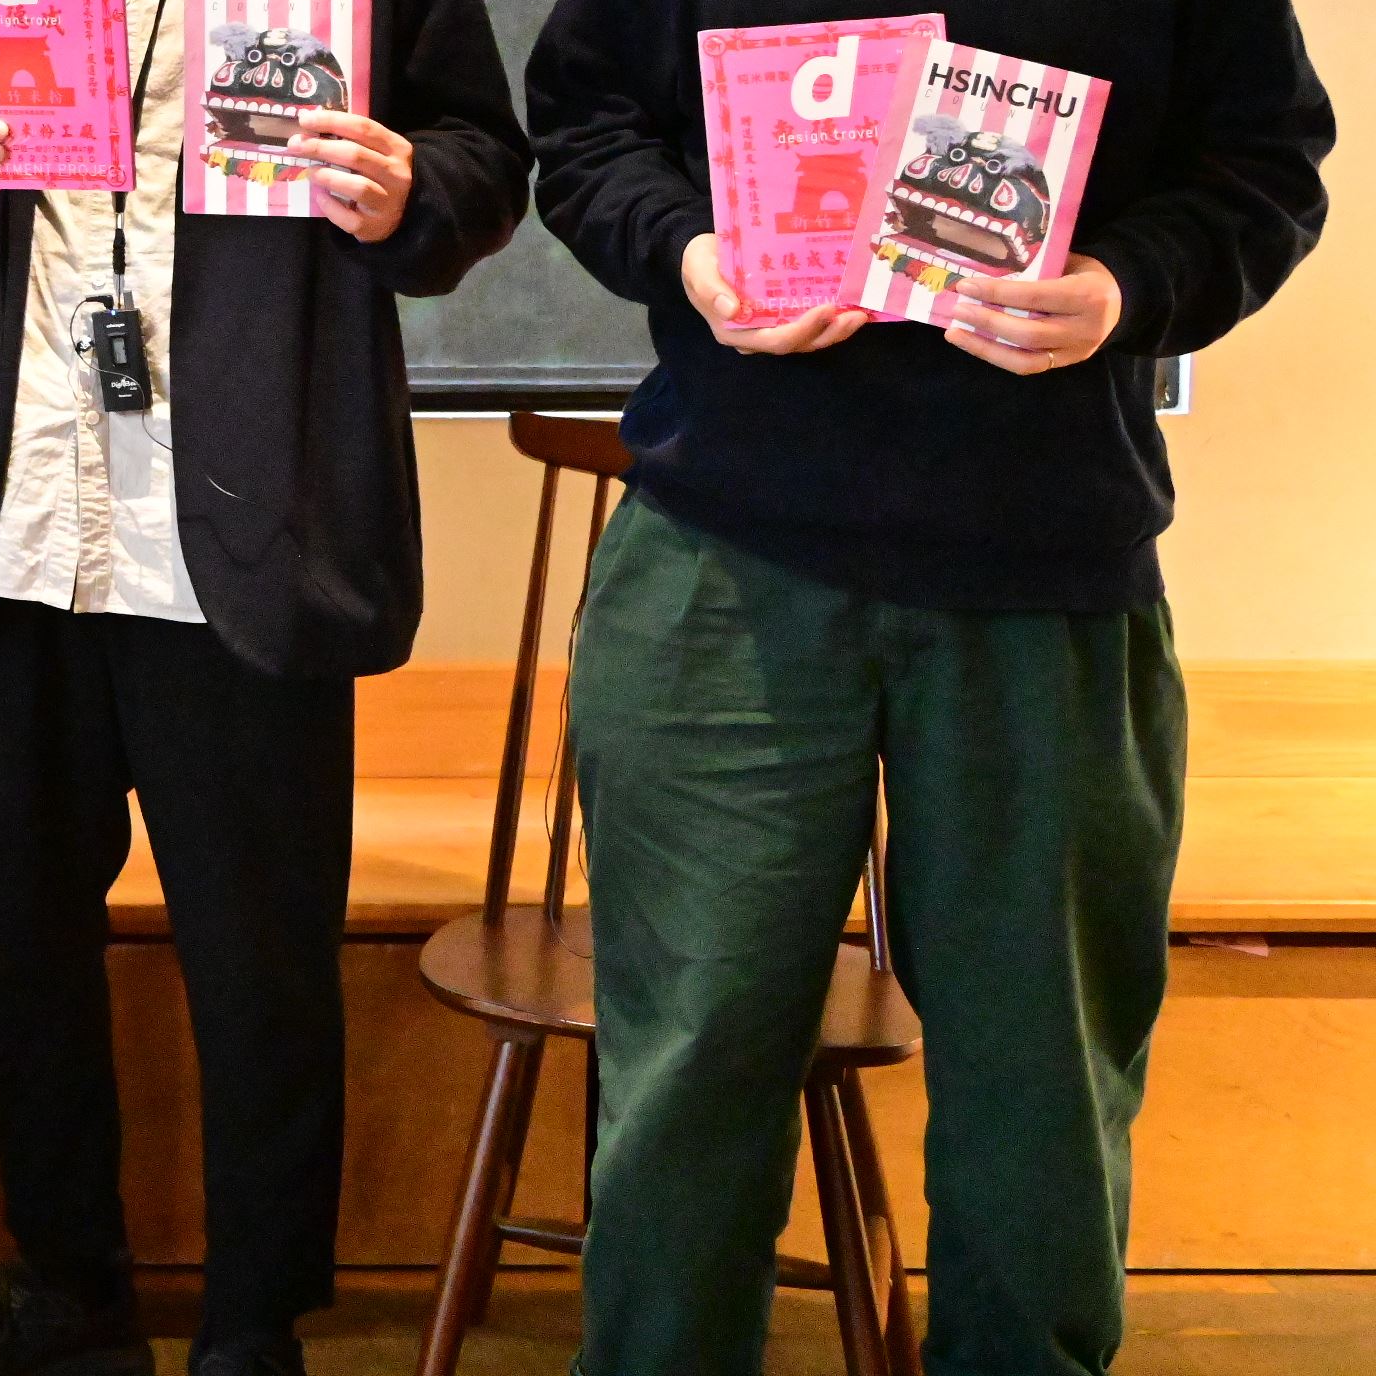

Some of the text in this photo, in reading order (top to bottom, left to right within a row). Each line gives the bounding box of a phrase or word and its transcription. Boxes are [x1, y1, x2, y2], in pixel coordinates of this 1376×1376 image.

[24, 15, 61, 25] travel
[791, 35, 859, 120] d
[928, 63, 1077, 118] HSINCHU
[778, 127, 878, 145] design travel
